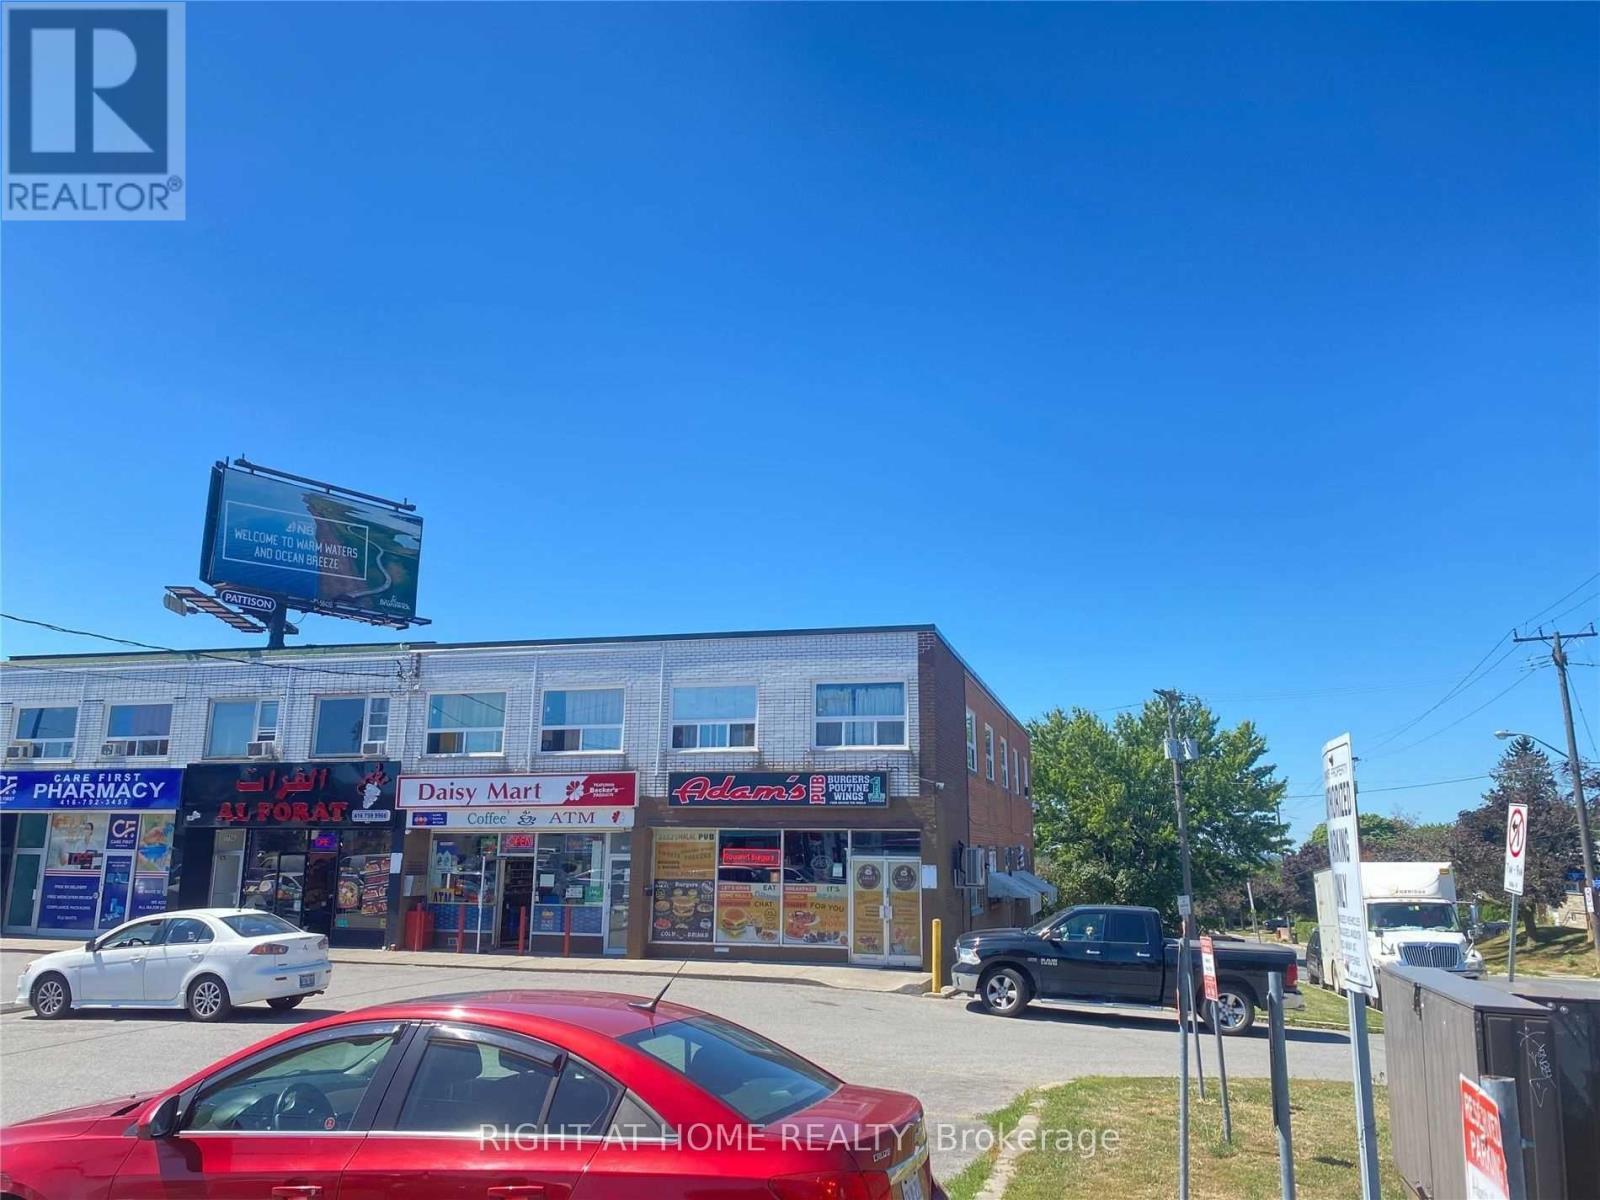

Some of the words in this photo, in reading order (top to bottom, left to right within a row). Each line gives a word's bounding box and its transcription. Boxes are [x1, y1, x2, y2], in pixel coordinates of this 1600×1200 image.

[234, 528, 278, 546] WELCOME
[282, 536, 293, 548] TO
[296, 538, 322, 552] WARM
[324, 543, 358, 559] WATERS
[254, 546, 273, 559] AND
[275, 549, 304, 564] OCEAN
[306, 554, 339, 569] BREEZE
[225, 593, 272, 609] PATTISON
[54, 774, 90, 783] CARE
[99, 773, 141, 782] FIRST
[827, 775, 870, 784] BURGERS
[33, 782, 166, 799] PHARMACY
[418, 782, 477, 805] Daisy
[488, 782, 542, 800] Mart
[672, 775, 806, 804] Adam's
[809, 775, 826, 804] PUB
[828, 784, 870, 792] POUTINE
[833, 792, 864, 801] WINGS
[216, 802, 249, 822] AL
[256, 802, 349, 823] FORAT
[467, 811, 507, 825] Coffee
[548, 811, 595, 824] ATM
[698, 833, 715, 841] PUB
